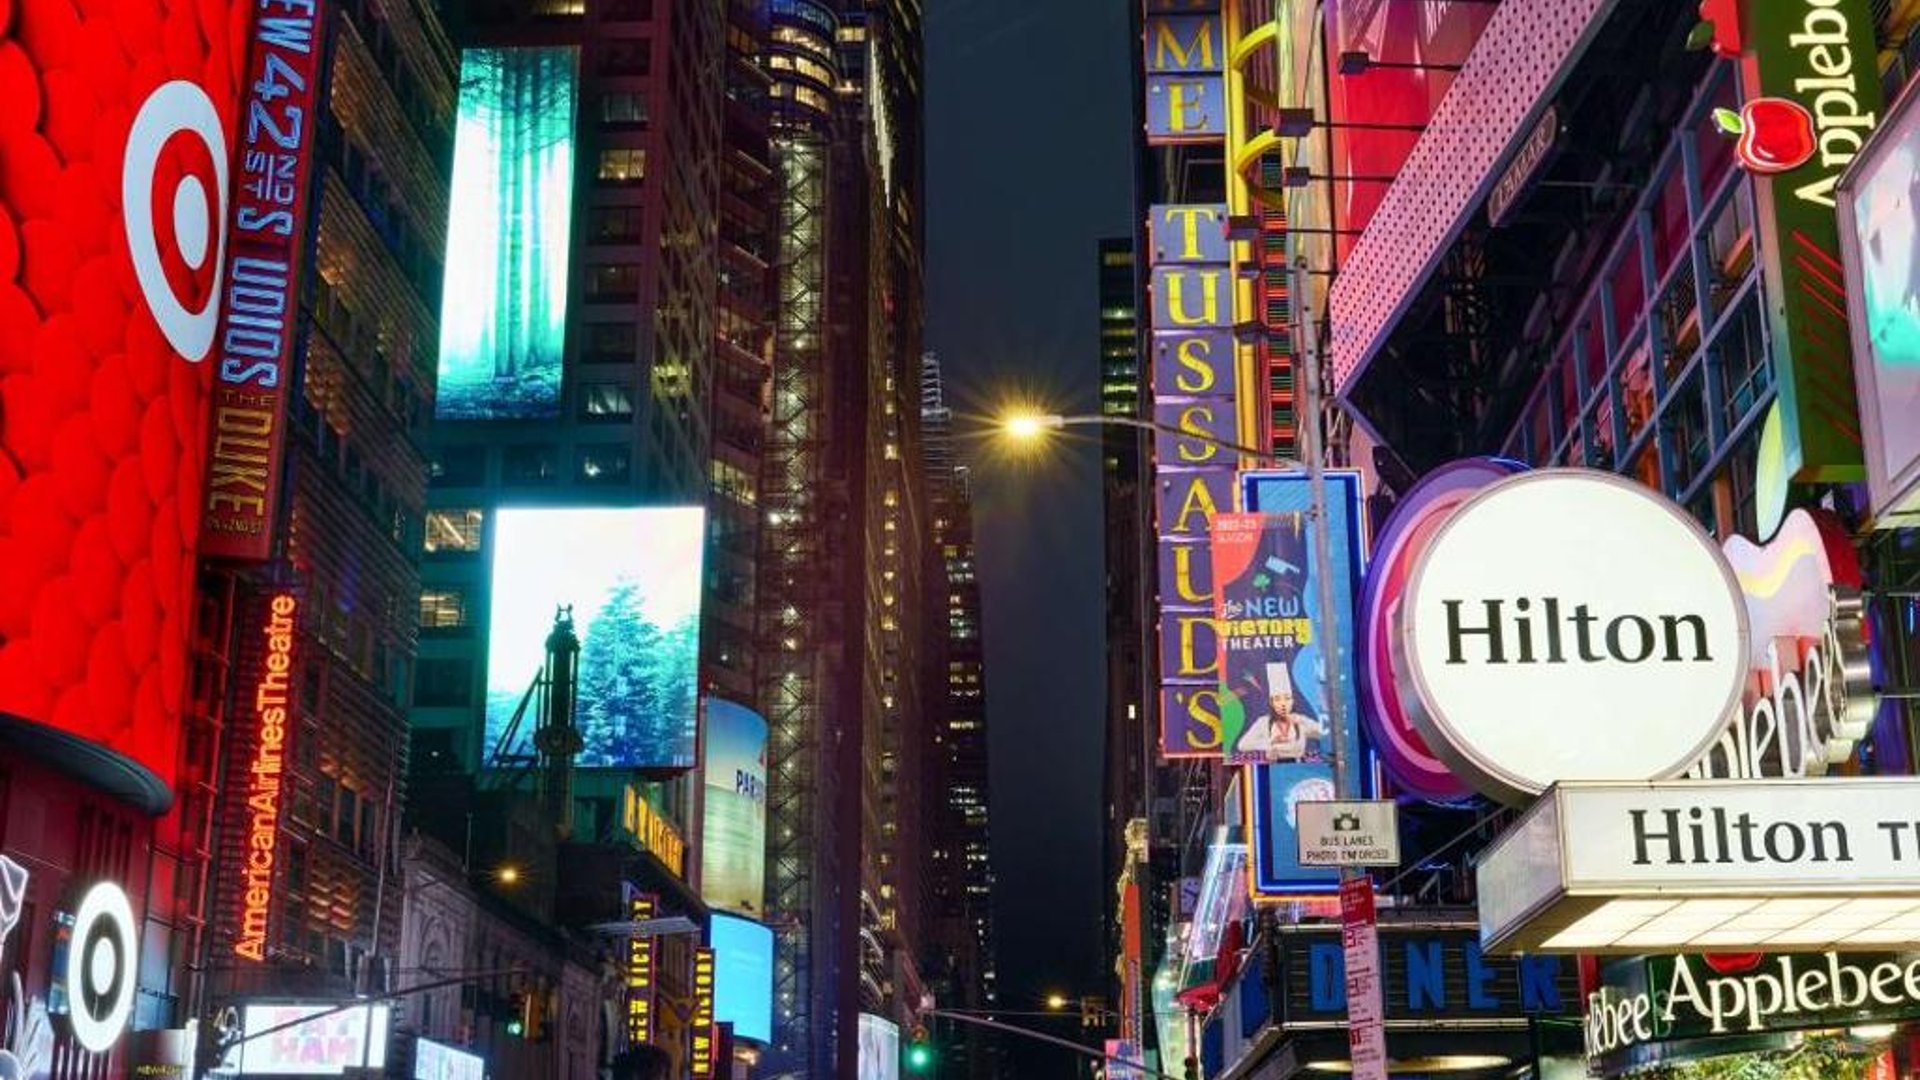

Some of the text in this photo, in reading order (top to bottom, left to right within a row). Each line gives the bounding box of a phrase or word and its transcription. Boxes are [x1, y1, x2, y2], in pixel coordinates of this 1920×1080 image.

[1789, 0, 1876, 208] Appleb
[221, 206, 293, 387] SUDIOS
[1244, 597, 1299, 617] NEW
[1443, 596, 1713, 664] Hilton
[1221, 634, 1294, 650] THEATER
[235, 594, 296, 961] AmericanAirlinesTheatre
[1628, 806, 1853, 865] Hilton
[1311, 940, 1563, 1011] DNER
